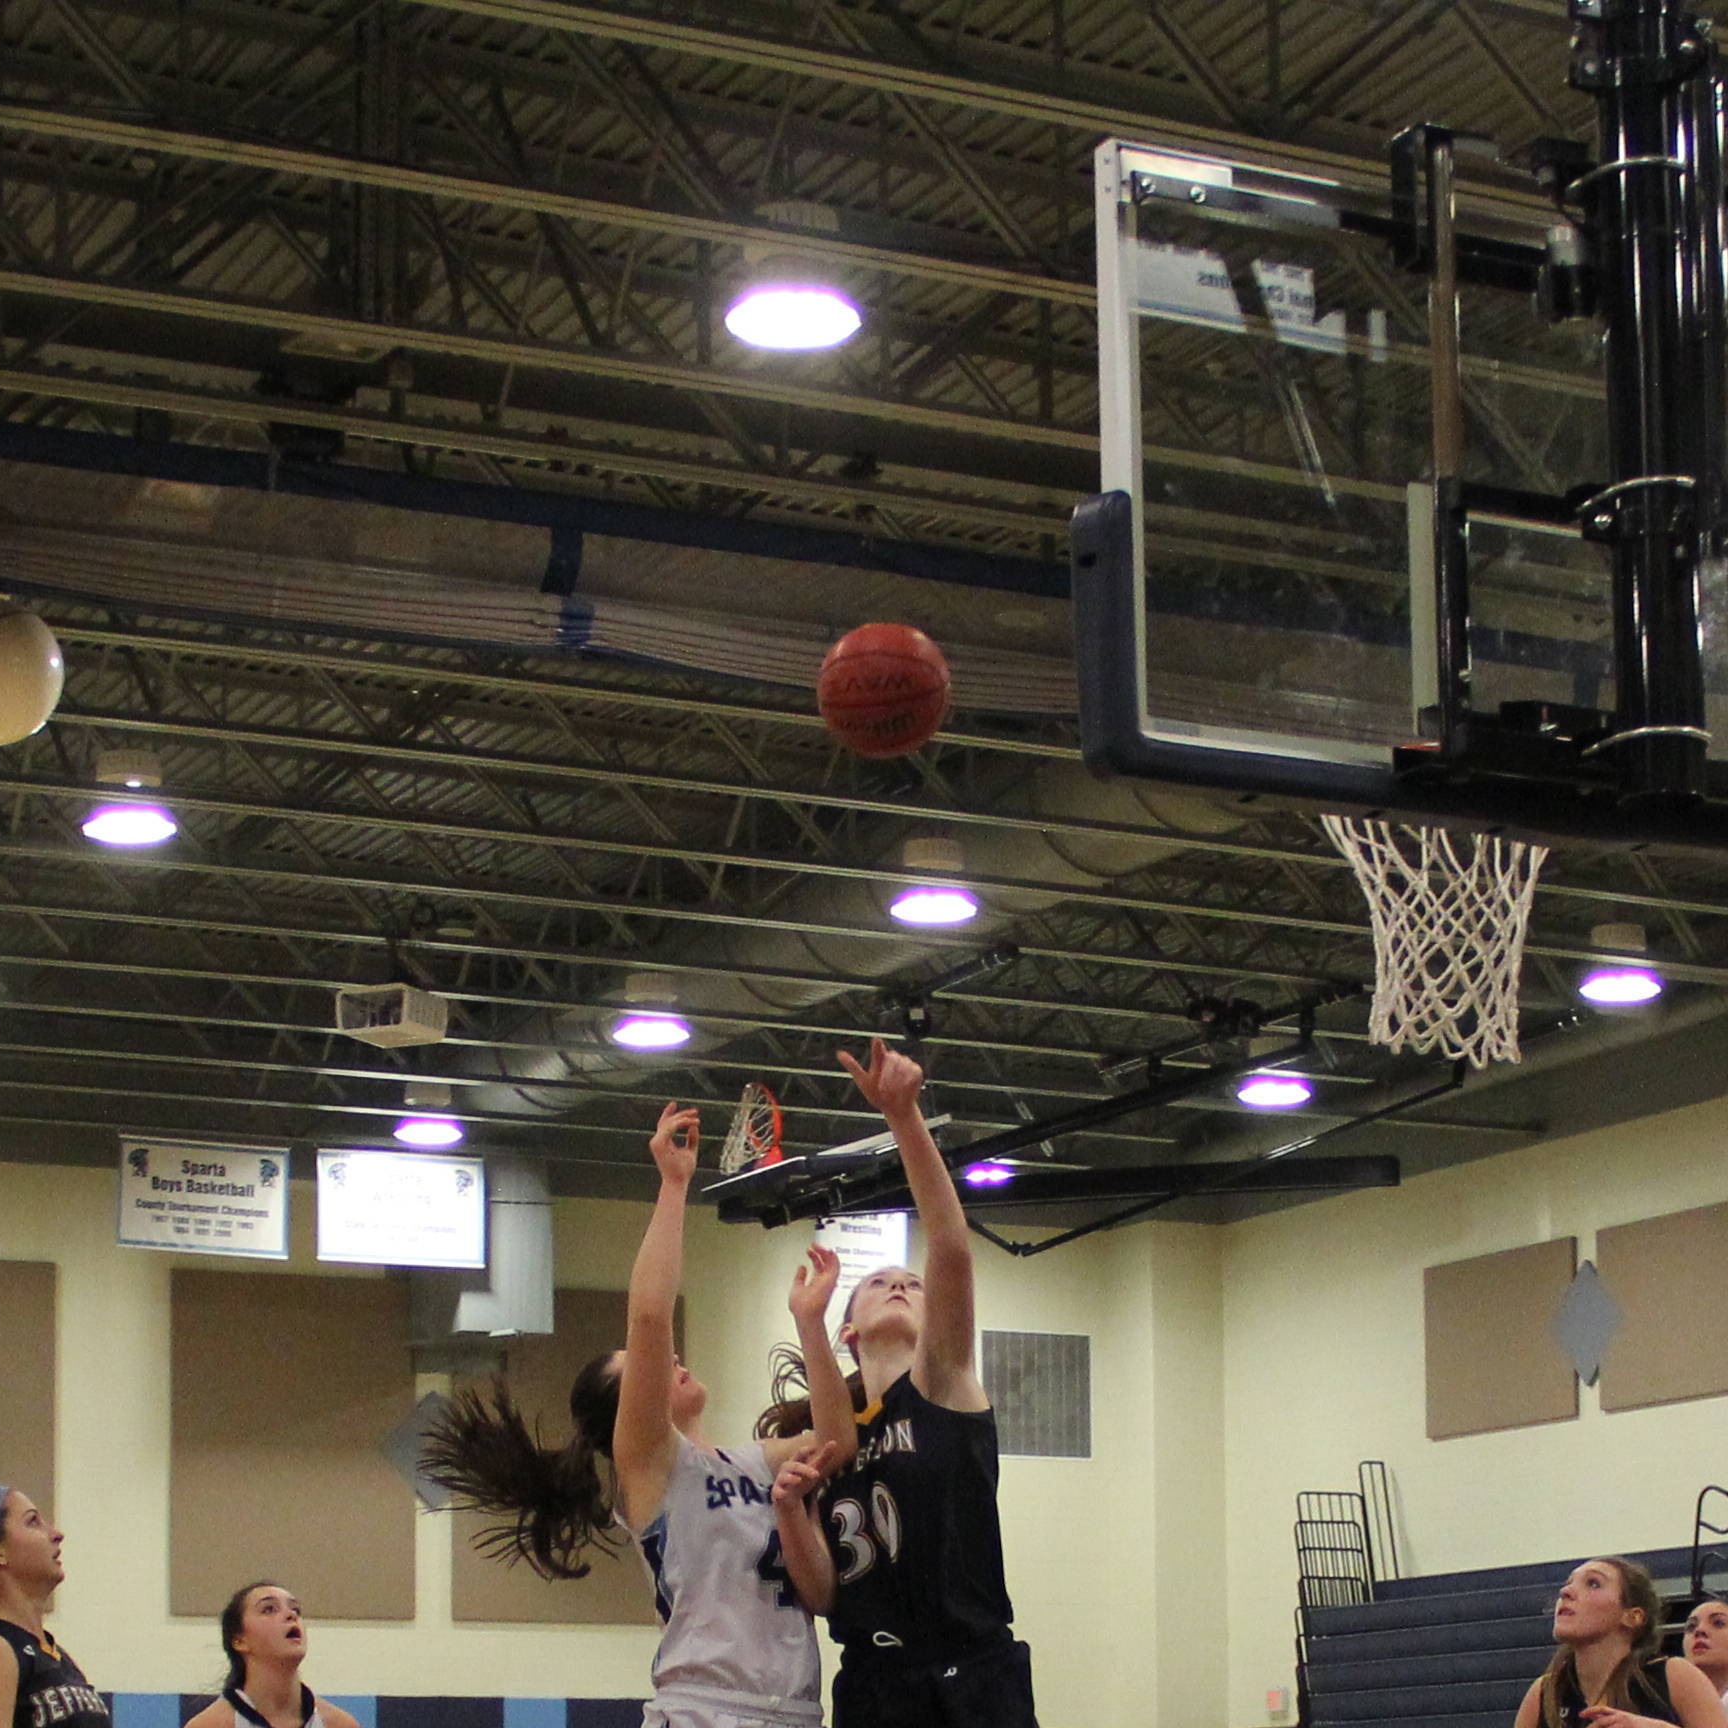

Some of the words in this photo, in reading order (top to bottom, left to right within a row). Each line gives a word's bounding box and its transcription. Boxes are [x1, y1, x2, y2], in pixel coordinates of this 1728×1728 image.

[181, 1159, 226, 1177] Sparta
[151, 1176, 183, 1193] Boys
[186, 1179, 255, 1197] Basketball
[831, 1481, 902, 1585] 30
